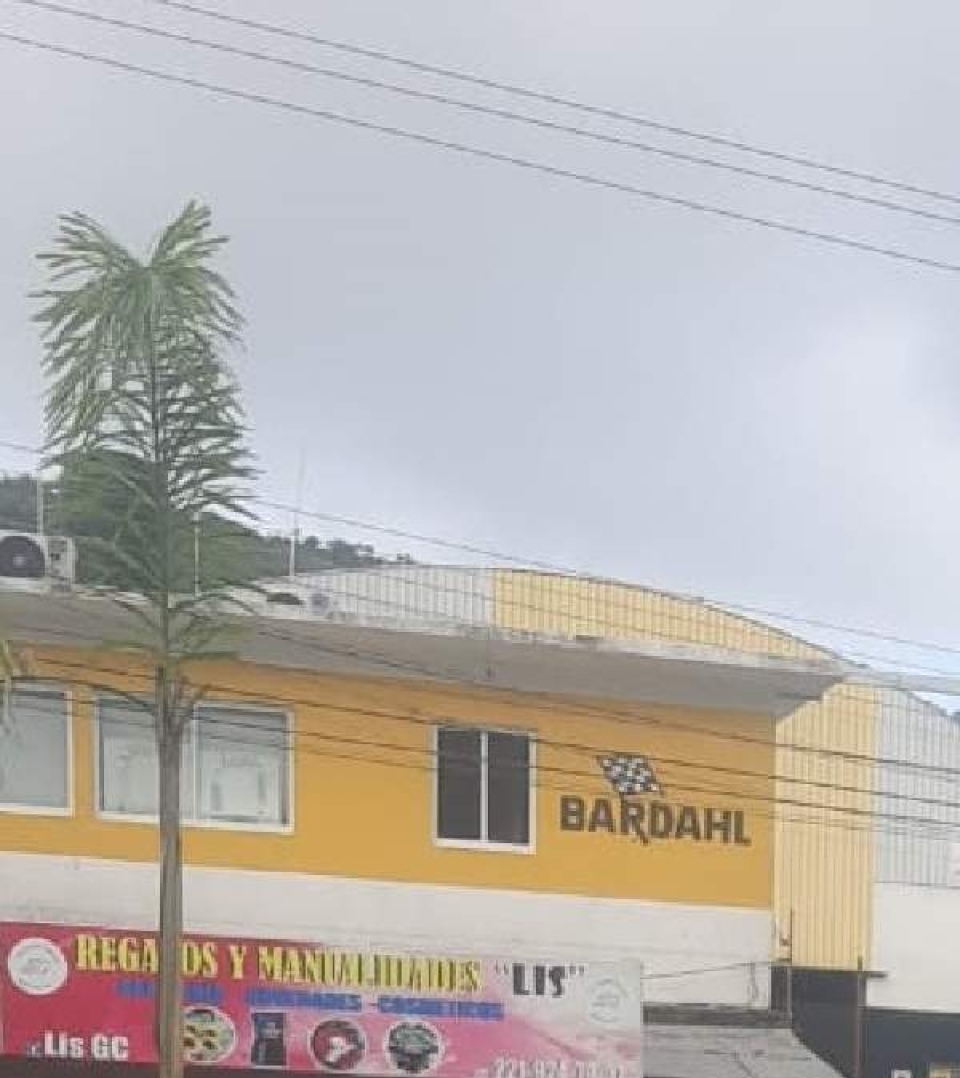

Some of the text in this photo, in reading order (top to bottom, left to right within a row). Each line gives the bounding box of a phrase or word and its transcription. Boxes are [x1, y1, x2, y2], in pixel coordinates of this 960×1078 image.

[559, 795, 751, 845] BARDAHL
[75, 934, 219, 978] REGAOS
[229, 945, 247, 979] Y
[258, 947, 482, 991] MANUALIDADES
[91, 1034, 129, 1061] GC
